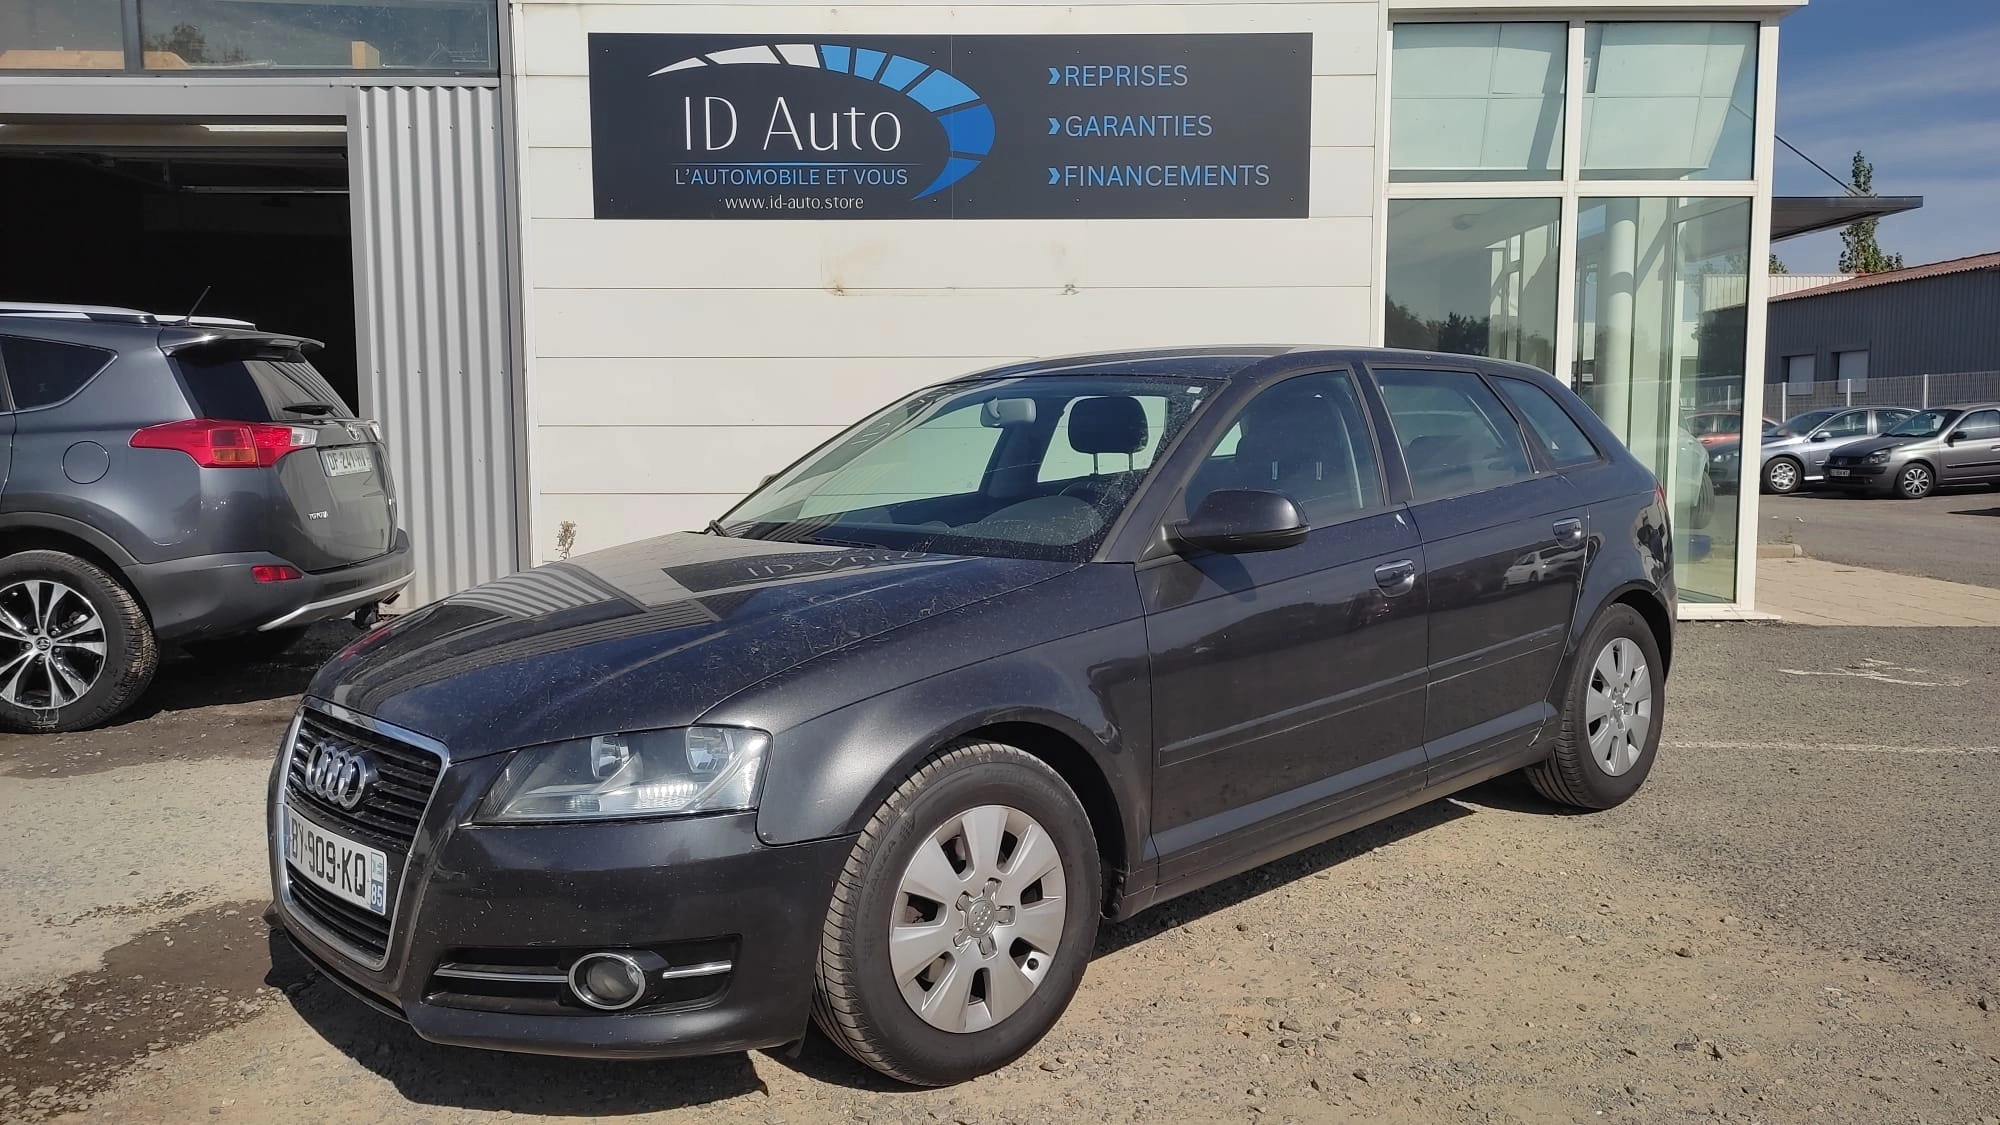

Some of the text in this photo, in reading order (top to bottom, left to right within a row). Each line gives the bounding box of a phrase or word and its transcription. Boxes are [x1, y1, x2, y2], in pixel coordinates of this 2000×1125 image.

[1064, 64, 1188, 87] REPRISES
[685, 96, 902, 152] ID Auto
[1064, 114, 1213, 137] GARANTIES
[826, 168, 849, 185] ET
[853, 168, 908, 185] VOUS
[1064, 164, 1270, 187] FINANCEMENTS
[724, 193, 864, 210] www.id-auto.store
[291, 817, 366, 899] BY-909-KQ
[371, 884, 383, 907] 85
